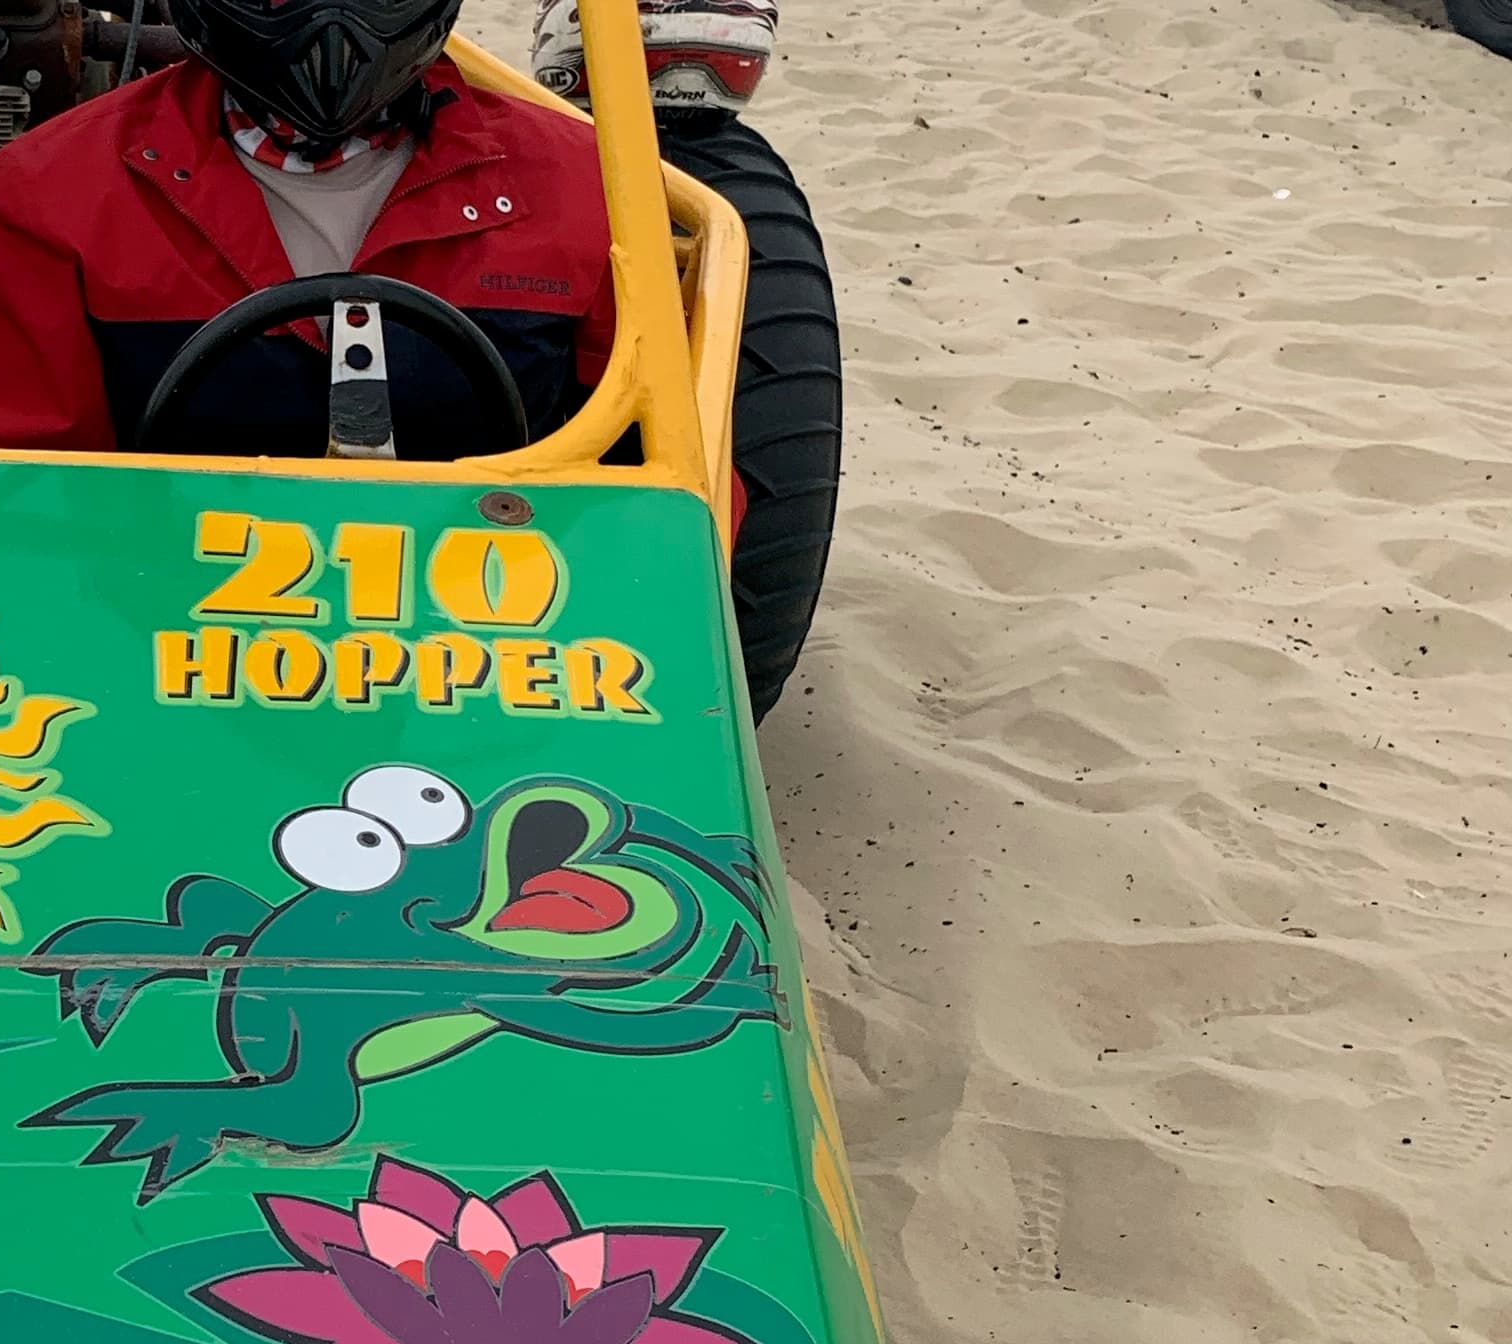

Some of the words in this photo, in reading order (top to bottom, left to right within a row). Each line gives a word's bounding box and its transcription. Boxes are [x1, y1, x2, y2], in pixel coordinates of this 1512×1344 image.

[479, 273, 571, 295] HILFIGER
[194, 511, 564, 630] 210
[156, 626, 656, 718] HOPPER
